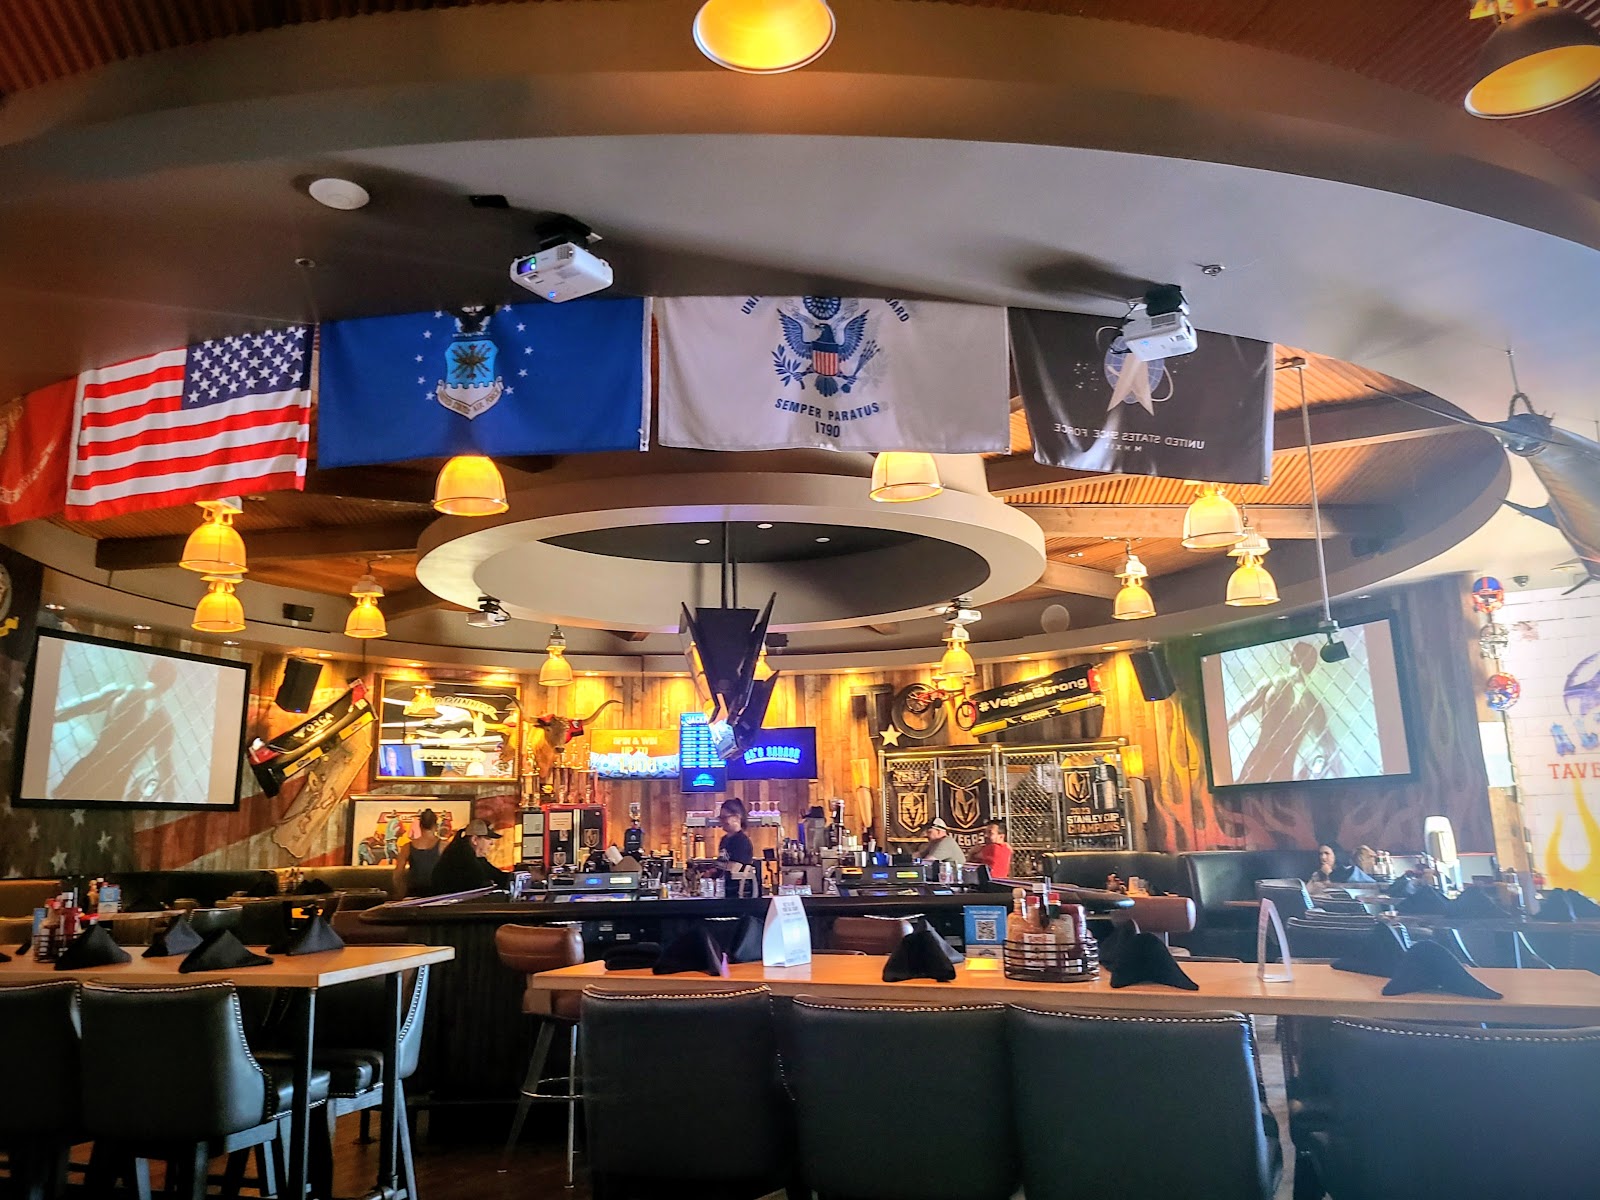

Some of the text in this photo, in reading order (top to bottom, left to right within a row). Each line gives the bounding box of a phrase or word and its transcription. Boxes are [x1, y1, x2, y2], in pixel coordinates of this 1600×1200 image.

[774, 398, 880, 421] SEMPER PARATUS
[815, 421, 841, 438] 1790
[978, 677, 1089, 713] #VegasStrong
[1066, 812, 1120, 825] STANLEY CUP
[1067, 822, 1121, 835] CHAMPIONS
[949, 831, 986, 848] VEGAS
